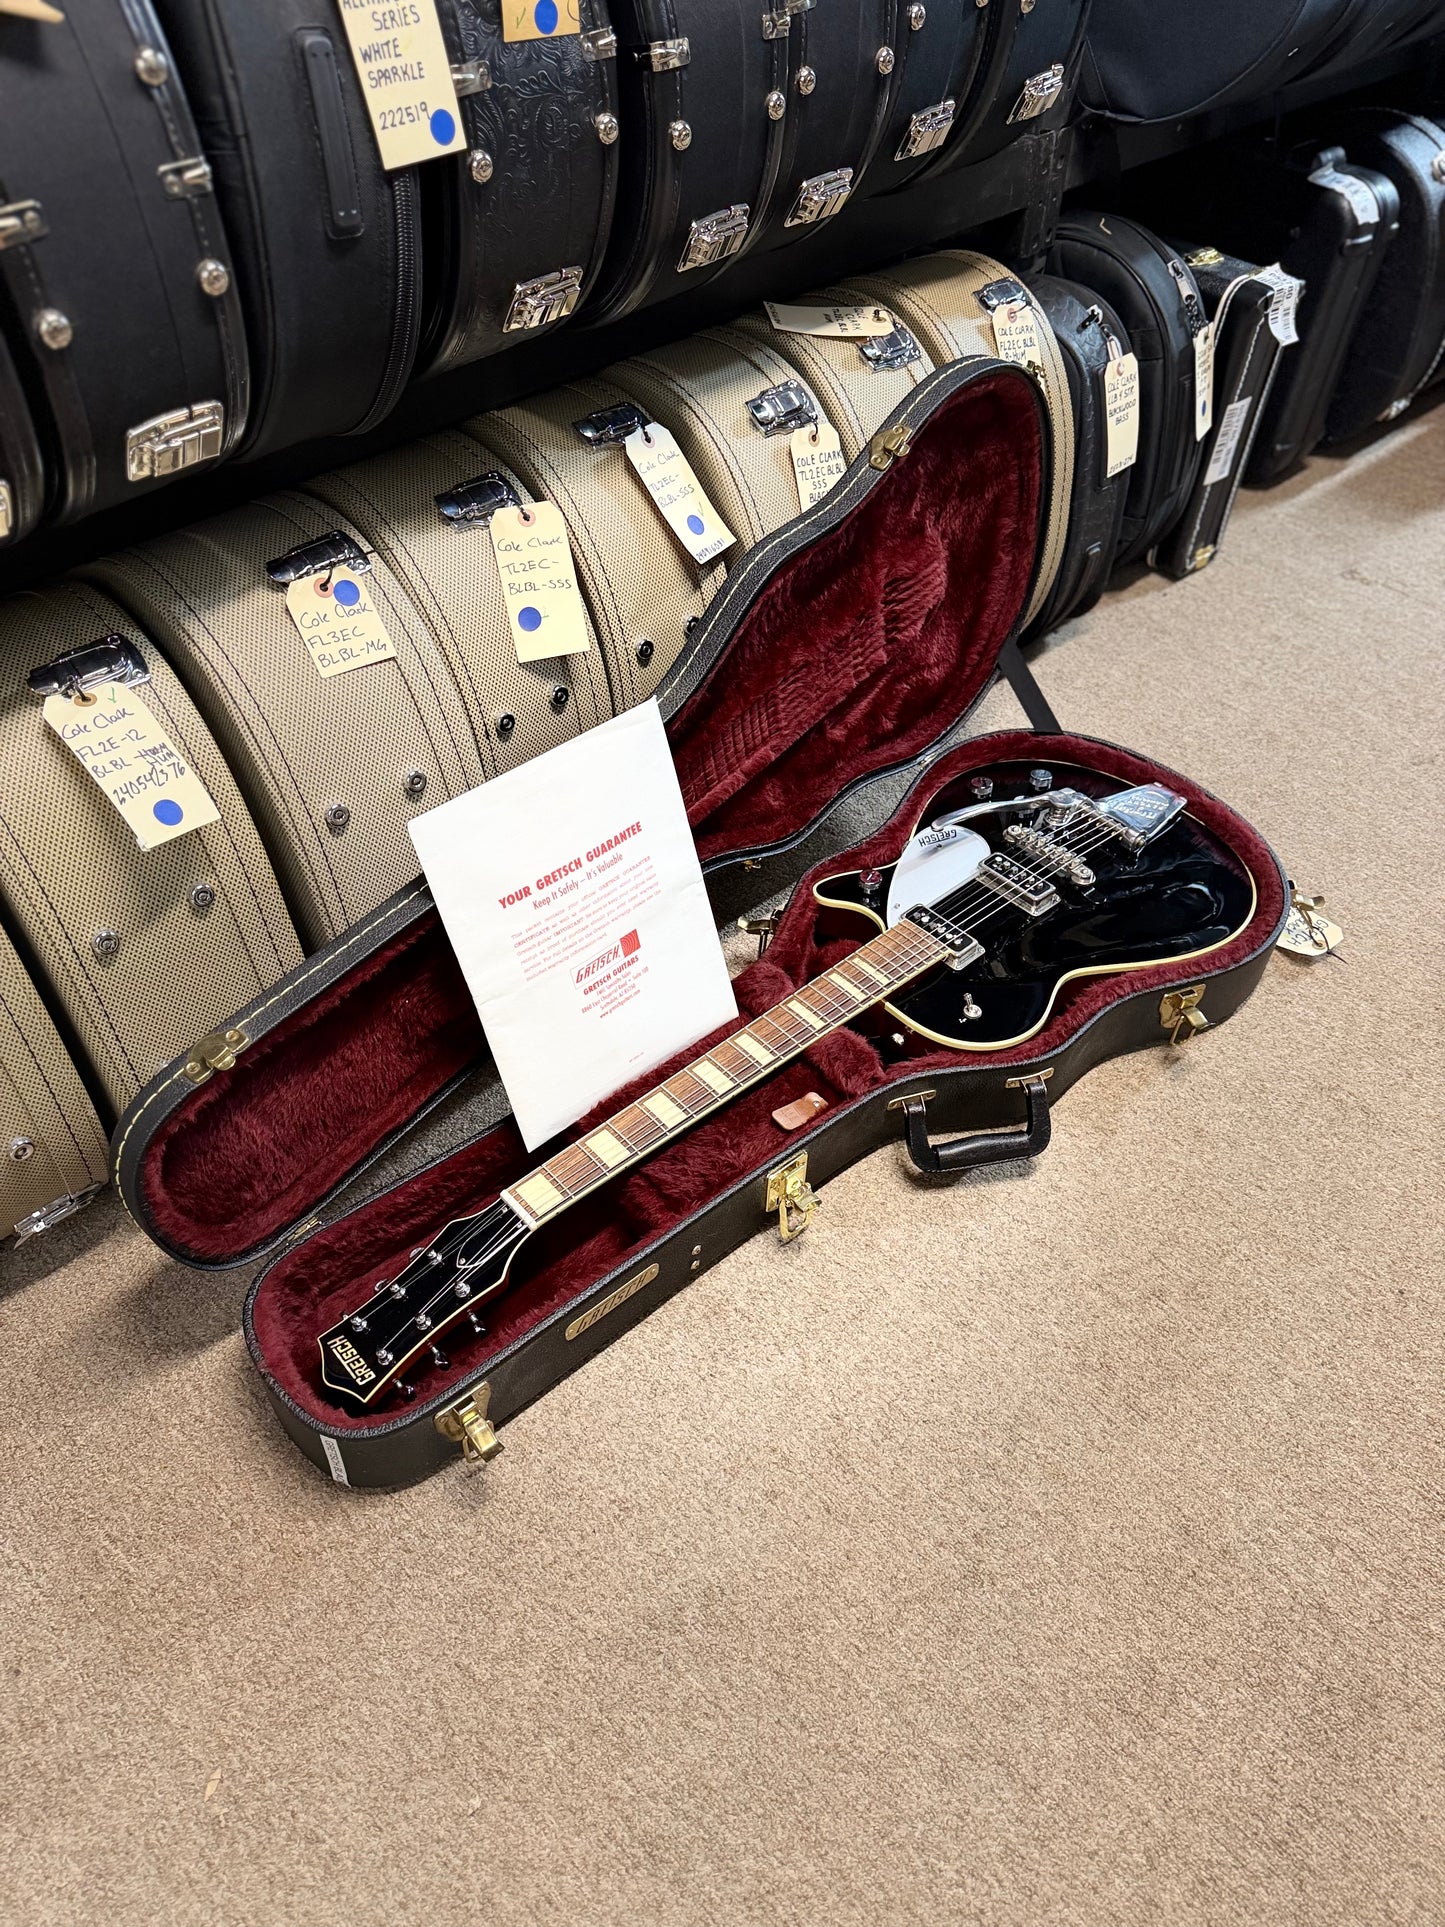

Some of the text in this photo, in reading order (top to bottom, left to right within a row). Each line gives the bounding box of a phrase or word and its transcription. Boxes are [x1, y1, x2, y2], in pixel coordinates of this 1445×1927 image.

[371, 4, 420, 31] SERIES
[359, 38, 402, 64] WHITE
[367, 61, 425, 89] SPARKLE
[379, 101, 430, 131] 222519
[998, 324, 1034, 336] COLE CLARK
[638, 449, 680, 474] Cole Clark
[797, 450, 842, 467] COLE CLARK
[799, 463, 843, 481] TL2EC BLBL
[812, 478, 827, 490] SSS
[497, 536, 563, 552] Cole Clark
[300, 602, 373, 629] Cole Clark
[307, 626, 365, 649] FL3EC
[61, 707, 135, 740] Cole Clark
[918, 828, 957, 848] GRETSCH
[498, 821, 642, 911] YOUR GRETSCH GUARANTEE
[532, 892, 551, 912] Keep
[551, 889, 558, 900] It
[557, 876, 580, 899] Safely
[585, 866, 597, 880] It's
[595, 850, 623, 874] Valuable
[513, 924, 549, 950] CERTIFICATE
[572, 943, 622, 984] GRETSCH
[582, 954, 639, 996] GRETSCH GUITARS
[327, 1335, 376, 1385] GRETSCH
